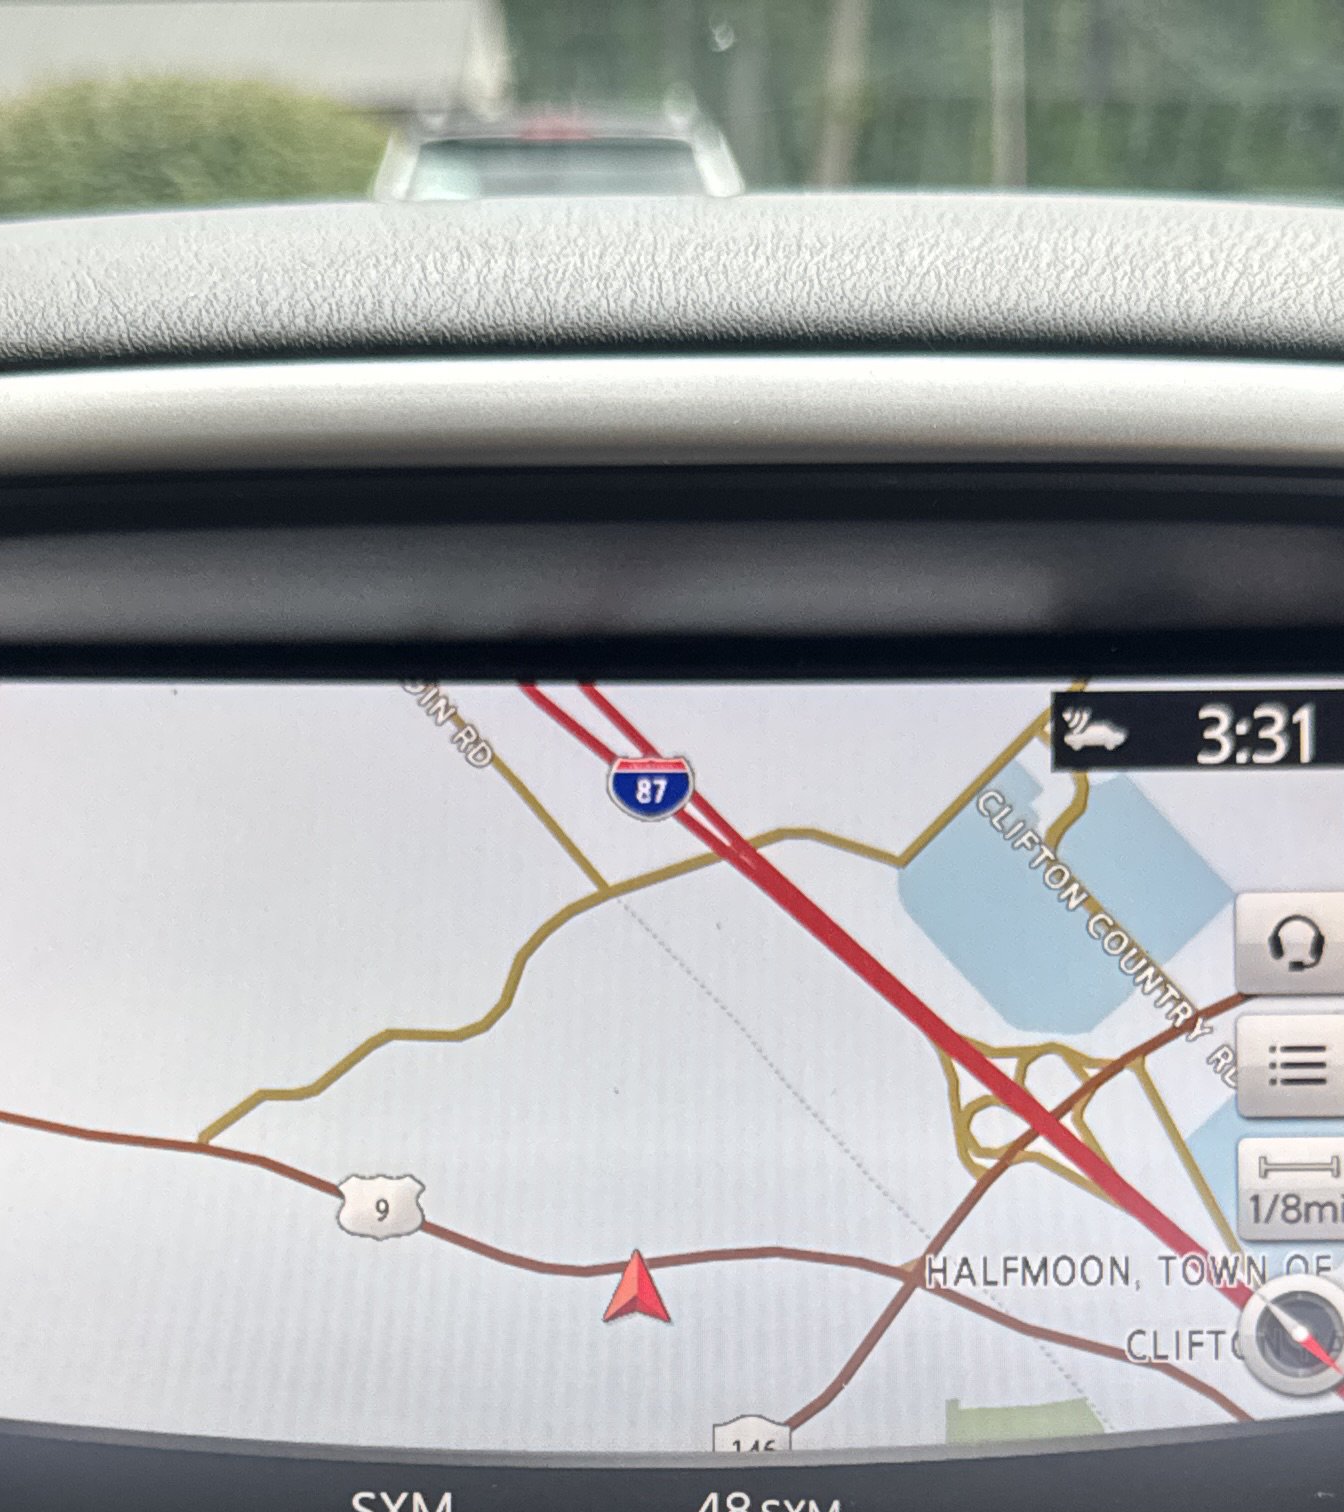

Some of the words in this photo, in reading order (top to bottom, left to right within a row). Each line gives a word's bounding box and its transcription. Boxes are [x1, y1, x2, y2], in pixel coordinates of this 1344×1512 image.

[450, 723, 494, 769] RD
[1196, 703, 1317, 765] 3:31
[636, 778, 668, 804] 87
[977, 789, 1087, 911] CLIFTON
[1086, 912, 1213, 1042] COUNTRY
[376, 1198, 389, 1222] 9
[926, 1255, 1141, 1291] HALFMOON,
[1158, 1255, 1266, 1286] TOWN
